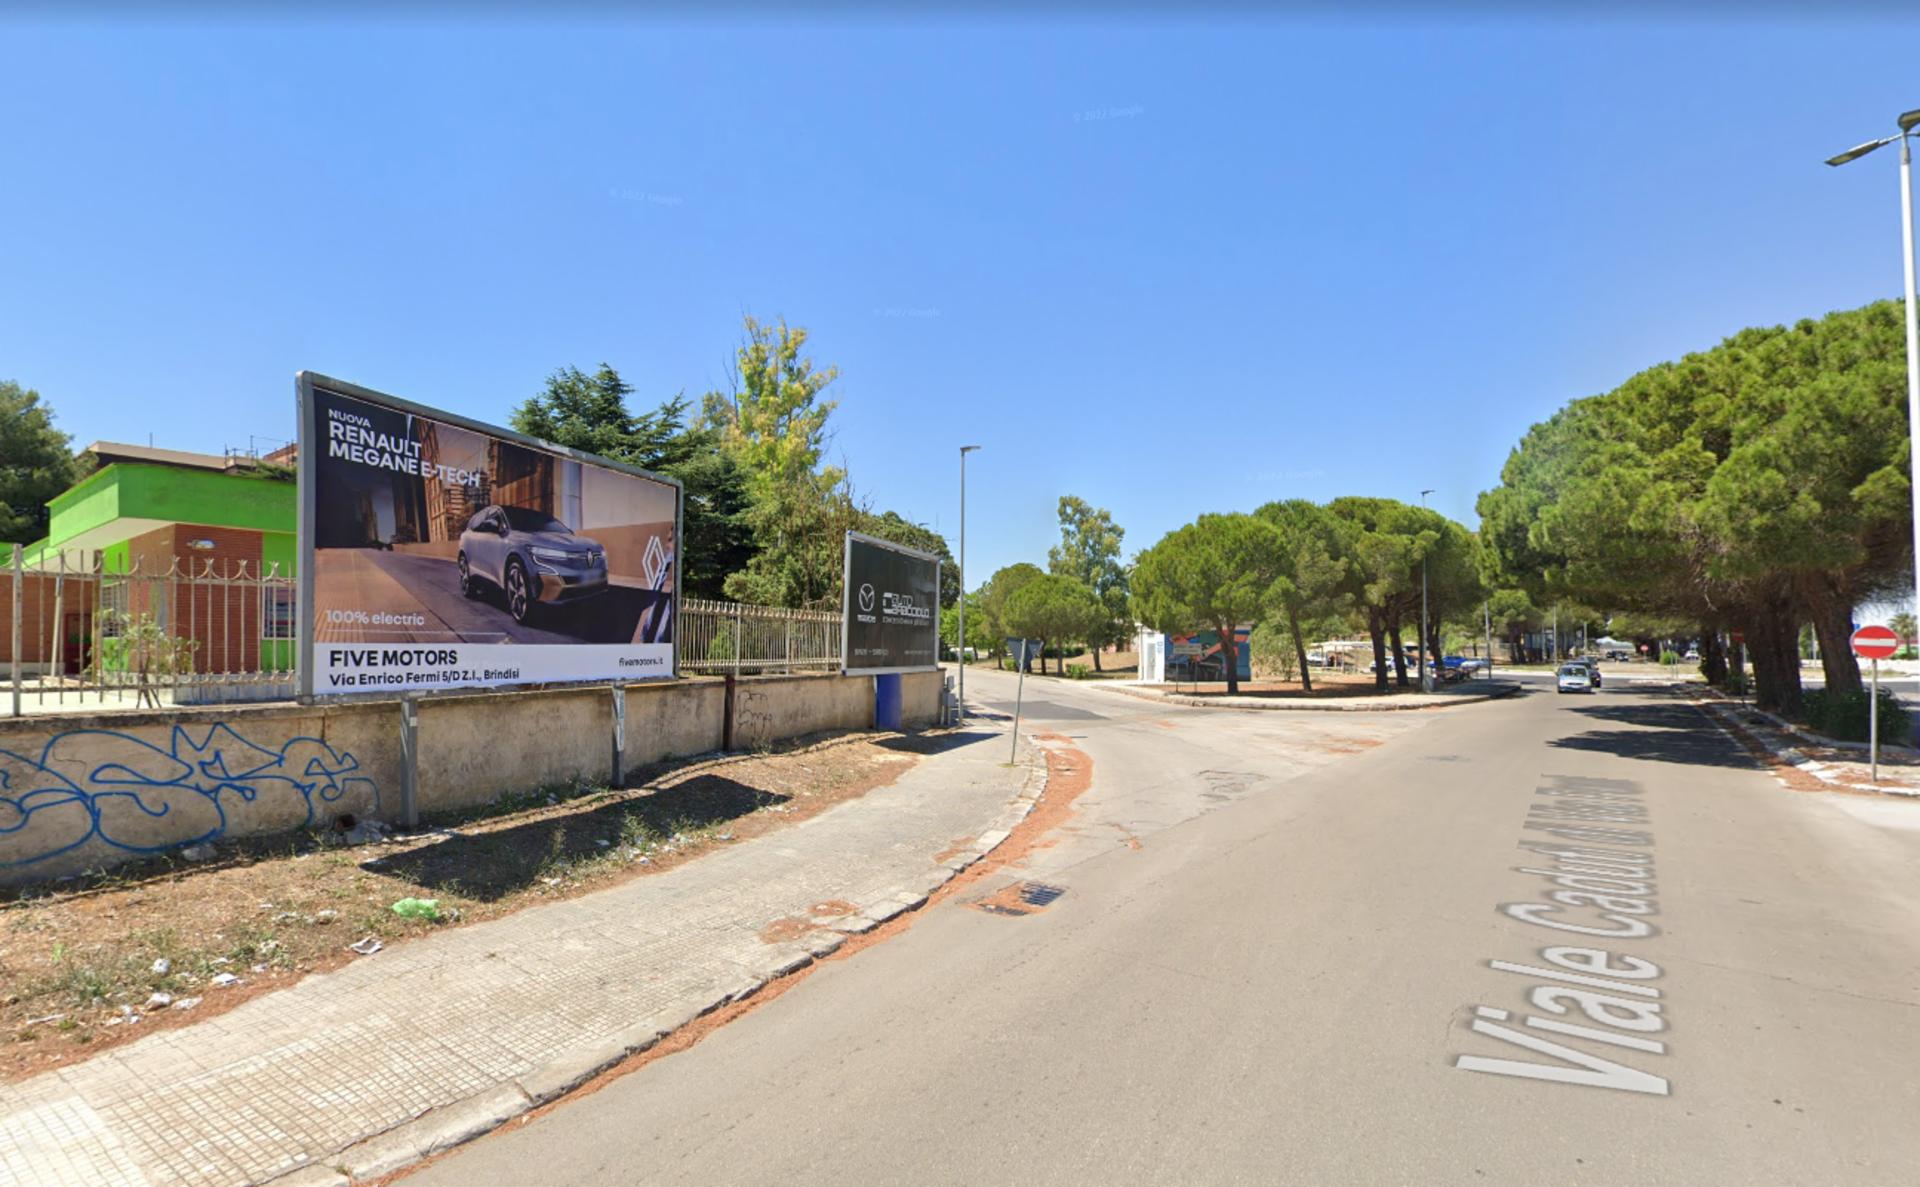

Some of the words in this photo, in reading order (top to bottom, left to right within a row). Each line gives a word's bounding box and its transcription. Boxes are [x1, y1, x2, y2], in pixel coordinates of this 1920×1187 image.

[328, 408, 371, 428] NUOVA
[329, 420, 422, 459] RENAULT
[329, 440, 418, 475] MEGANE
[420, 459, 480, 488] E-TECH
[326, 609, 370, 625] 100%
[371, 611, 425, 626] electric
[329, 650, 378, 667] FIVE
[381, 650, 458, 666] MOTORS
[329, 672, 356, 686] Via
[359, 672, 404, 685] Enrico
[406, 671, 440, 683] Fermi
[442, 670, 460, 683] 5/D
[483, 668, 520, 680] Brindisi
